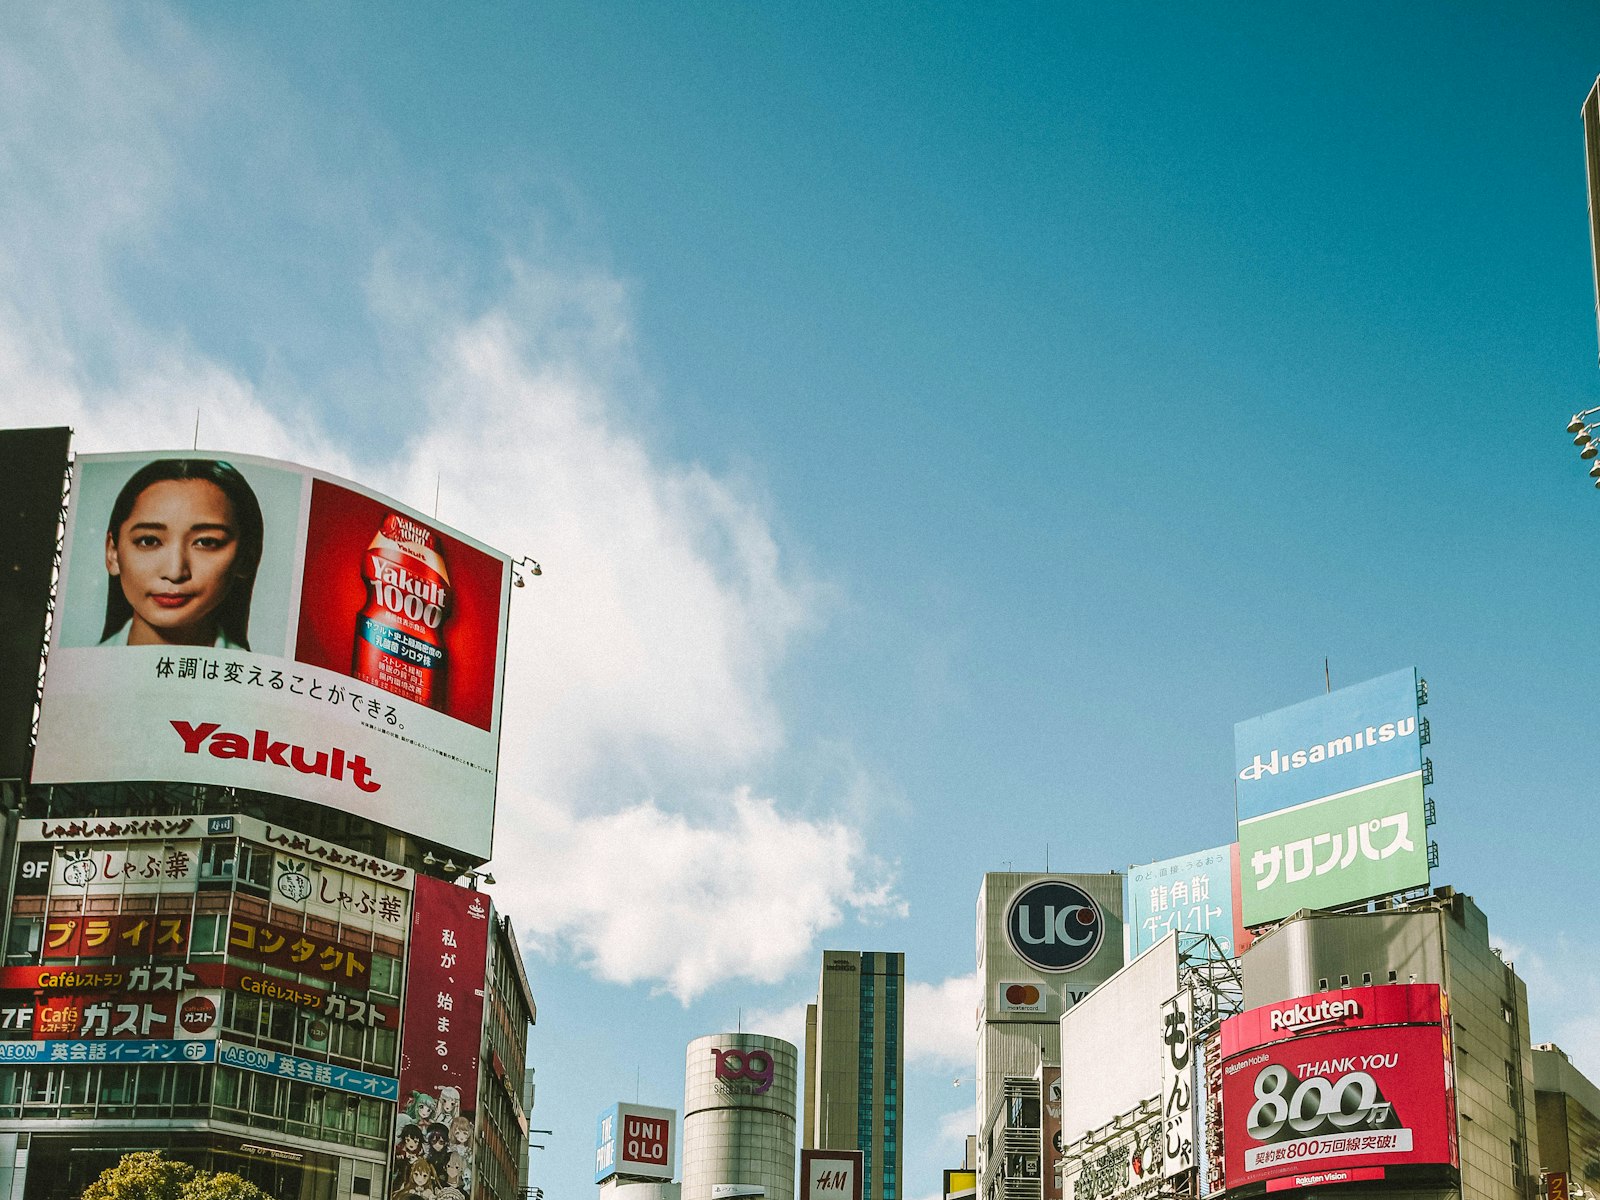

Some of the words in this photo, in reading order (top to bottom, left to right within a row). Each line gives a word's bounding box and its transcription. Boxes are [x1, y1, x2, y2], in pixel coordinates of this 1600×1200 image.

[371, 555, 446, 607] Yakult
[370, 580, 443, 630] 1000
[169, 720, 382, 793] Yakult
[1239, 716, 1415, 780] Hisamitsu
[103, 852, 190, 879] しゃぶ葉
[1251, 811, 1414, 891] サロンパス
[22, 861, 49, 878] 9F
[320, 876, 401, 923] しゃぶ葉
[1150, 873, 1210, 913] 龍角散
[48, 918, 184, 948] プライス
[229, 921, 366, 977] コンタクト
[127, 965, 196, 991] ガスト
[41, 1007, 78, 1023] Café
[324, 993, 386, 1027] ガスト
[435, 929, 457, 1071] 私が、始まる。
[1270, 999, 1359, 1034] Rakuten
[1, 1008, 34, 1029] 7F
[80, 1002, 167, 1037] ガスト
[184, 1013, 212, 1023] ガスト
[50, 1042, 176, 1061] 英会話イーオン
[185, 1046, 205, 1057] 6F
[1225, 1061, 1248, 1075] Rakuten
[1248, 1054, 1269, 1068] Mobile
[1297, 1057, 1355, 1079] THANK
[1360, 1053, 1398, 1070] YOU
[226, 1048, 269, 1067] AEON
[278, 1056, 395, 1095] 英会話イーオン
[711, 1049, 774, 1095] 109
[1164, 1000, 1193, 1165] もんじゃ
[629, 1120, 661, 1140] UNI
[628, 1140, 663, 1159] QLO
[817, 1170, 848, 1191] H&M
[1295, 1176, 1324, 1186] Rakuten
[1324, 1172, 1347, 1182] Vision
